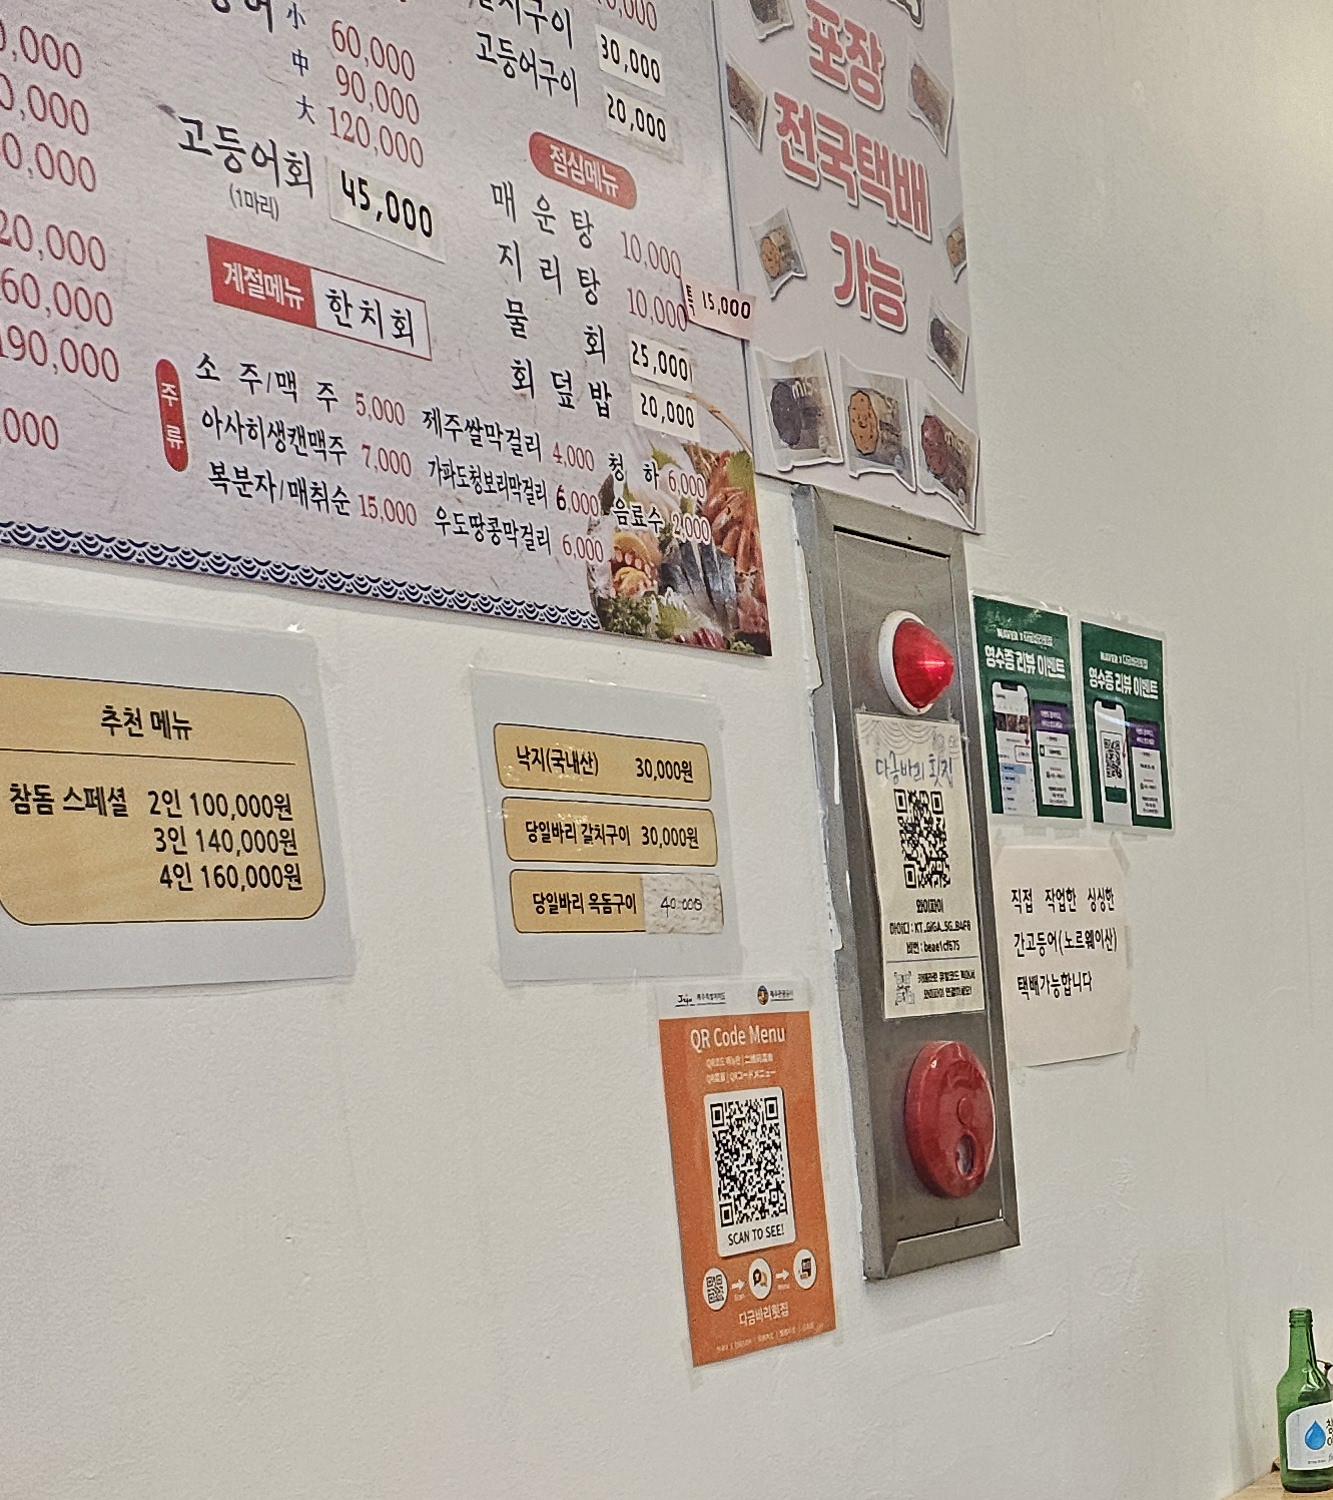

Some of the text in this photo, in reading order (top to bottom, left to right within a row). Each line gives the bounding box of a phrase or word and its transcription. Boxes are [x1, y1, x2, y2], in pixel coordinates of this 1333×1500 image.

[286, 1, 416, 82] 小 60,000
[804, 0, 886, 112] 포장
[291, 48, 421, 126] 中 90,000
[475, 31, 661, 108] 고등어구이 30,000
[295, 94, 426, 169] 大 120,000
[605, 92, 668, 143] 20,000
[178, 116, 315, 199] 고등어회
[549, 146, 620, 199] 점심메뉴
[774, 91, 932, 242] 전국택배
[228, 182, 281, 222] (1마리)
[340, 169, 434, 239] 45,000
[620, 230, 682, 280] 10,000
[830, 230, 907, 333] 가능
[222, 260, 415, 349] 계절메뉴 한치회
[627, 286, 689, 333] 10,000
[701, 290, 752, 320] 15,000
[631, 340, 688, 382] 25,000
[355, 390, 407, 427] 5,000
[640, 392, 696, 429] 20,000
[201, 404, 413, 478] 아사히생캔맥주 7,000
[422, 407, 596, 473] 제주쌀막걸리 4,000
[208, 460, 418, 528] 복분자/매취순 15,000
[428, 455, 548, 510] 가파도청보리막걸리
[668, 469, 707, 500] 6,000
[434, 505, 605, 564] 우도땅콩막걸리 6,000
[612, 498, 665, 535] 음료수
[984, 645, 1066, 680] 영수증 리뷰 이벤트
[1089, 667, 1159, 700] 영수증 리뷰 이벤트
[100, 704, 193, 741] 추천 메뉴
[516, 745, 694, 784] 낙지(국내산) 30,000원
[10, 783, 294, 822] 참돔 스페셜 2인 100,000원
[154, 825, 299, 857] 3인 140,000원
[525, 820, 699, 849] 당일바리 갈치구이 30,000원
[159, 862, 303, 893] 4인 160,000원
[532, 892, 584, 916] 당일바리
[1011, 887, 1115, 914] 직접 작업한 싱싱한
[1013, 927, 1118, 958] 간고등어(노르웨이산)
[1017, 970, 1093, 1001] 택배가능합니다
[690, 1024, 786, 1054] QR Code Menu
[728, 1223, 785, 1246] SCAN TO SEE!
